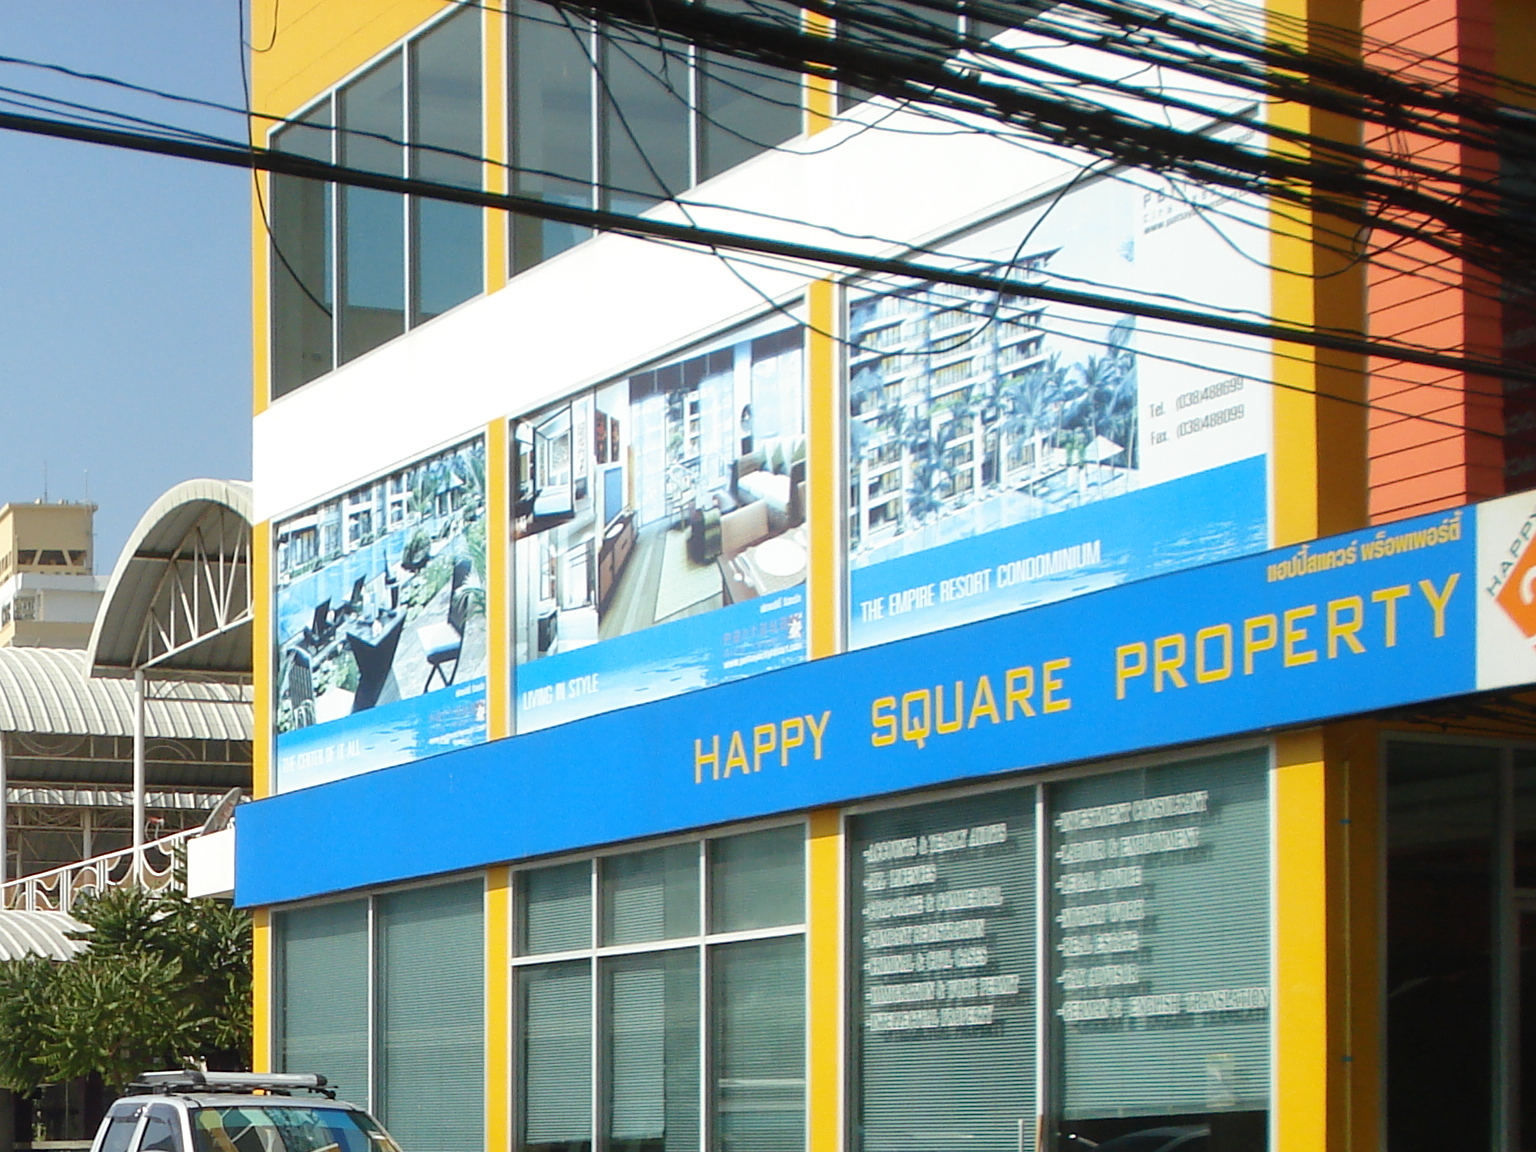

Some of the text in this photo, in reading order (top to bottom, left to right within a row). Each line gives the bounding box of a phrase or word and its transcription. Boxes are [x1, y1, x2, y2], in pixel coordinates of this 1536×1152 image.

[860, 540, 1101, 622] THE EMPIRE RESORT CONDOMINIUM
[522, 673, 600, 711] LIVING IN STYLE
[694, 572, 1461, 784] HAPPY SQUARE PROPERTY
[1185, 988, 1270, 1013] TRANSLATION
